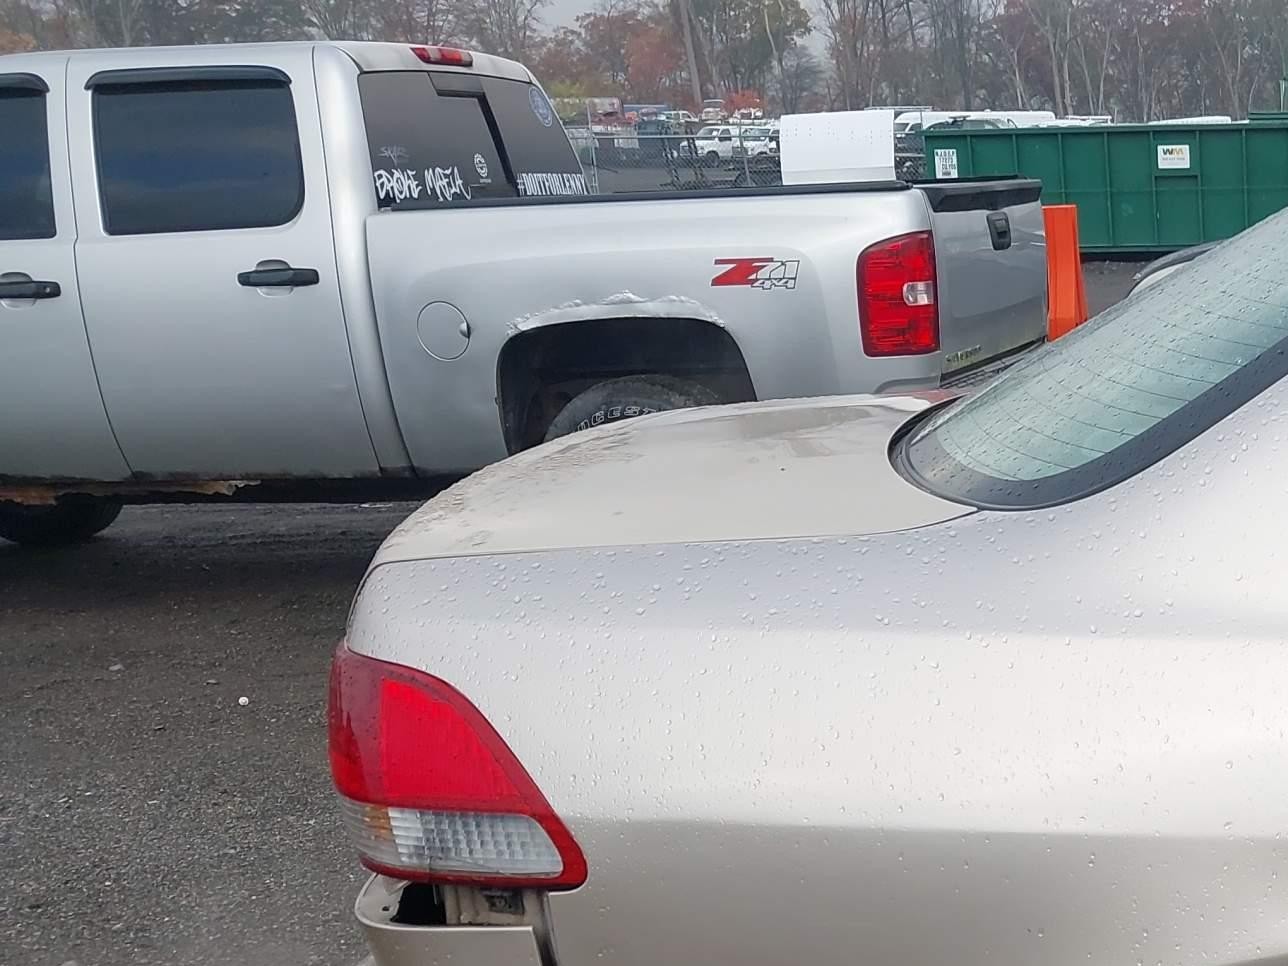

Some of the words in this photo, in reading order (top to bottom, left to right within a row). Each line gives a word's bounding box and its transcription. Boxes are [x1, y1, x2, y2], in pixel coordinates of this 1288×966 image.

[1162, 147, 1185, 156] WM
[425, 166, 471, 202] MAFIA
[516, 173, 588, 196] #DOITFORLENNY
[711, 257, 800, 287] Z71
